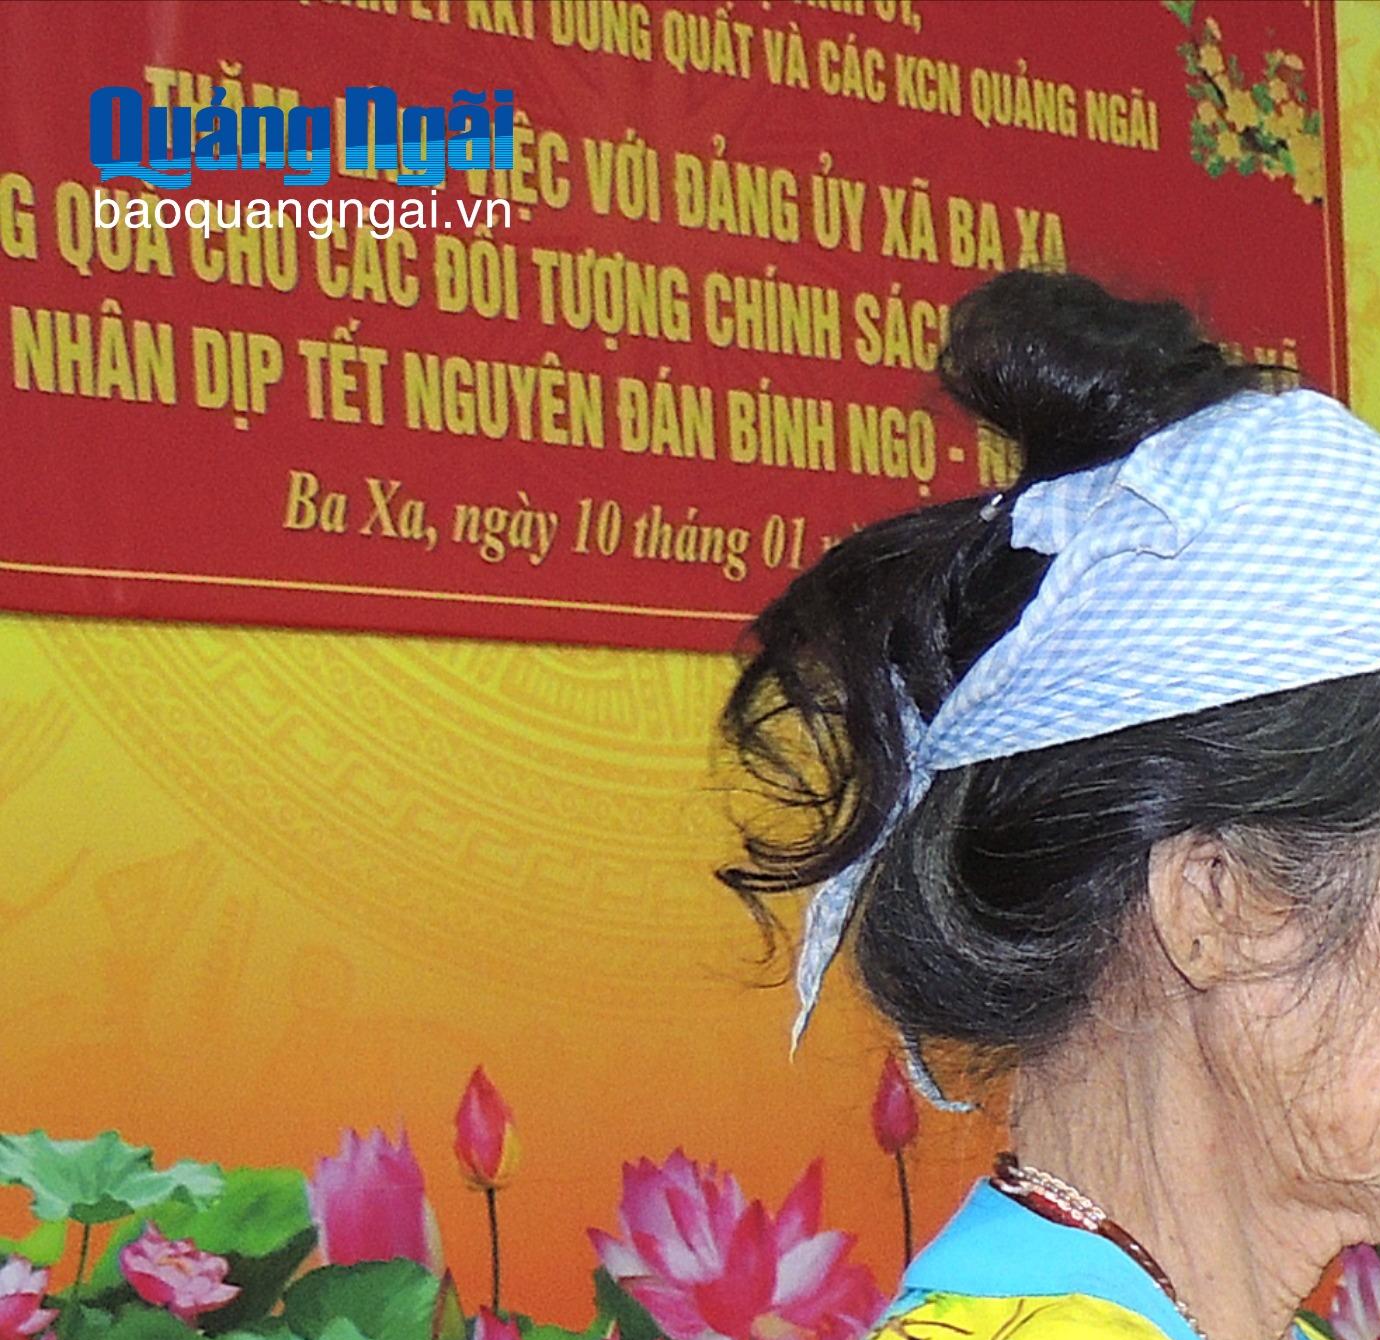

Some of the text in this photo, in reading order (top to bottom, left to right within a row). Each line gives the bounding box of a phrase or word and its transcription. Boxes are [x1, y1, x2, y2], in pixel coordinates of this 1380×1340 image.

[549, 0, 652, 62] DUNG
[662, 5, 755, 79] QUẤT
[762, 22, 811, 91] VÀ
[817, 33, 887, 103] CÁC
[895, 54, 962, 117] KCN
[970, 59, 1078, 138] QUẢNG
[1085, 88, 1160, 151] NGÃI
[582, 128, 661, 222] VỚI
[672, 134, 801, 244] ĐẢNG
[810, 152, 867, 253] ỦY
[878, 178, 939, 263] XÃ
[947, 196, 1006, 273] BA
[1015, 208, 1068, 274] XA
[189, 202, 301, 292] CHO
[315, 207, 421, 308] CÁC
[433, 214, 520, 321] ĐỐI
[531, 247, 692, 350] TƯỢNG
[703, 265, 842, 361] CHÍNH
[10, 298, 177, 405] NHÂN
[191, 326, 285, 431] DỊP
[297, 318, 389, 427] TẾT
[403, 351, 605, 450] NGUYÊN
[616, 366, 717, 460] ĐÁN
[727, 378, 836, 473] BÍNH
[847, 402, 938, 498] NGỌ
[282, 470, 347, 534] Ba
[359, 478, 438, 551] Xa,
[452, 491, 558, 567] ngày
[574, 498, 623, 556] 10
[633, 505, 750, 582] tháng
[761, 514, 806, 570] 01
